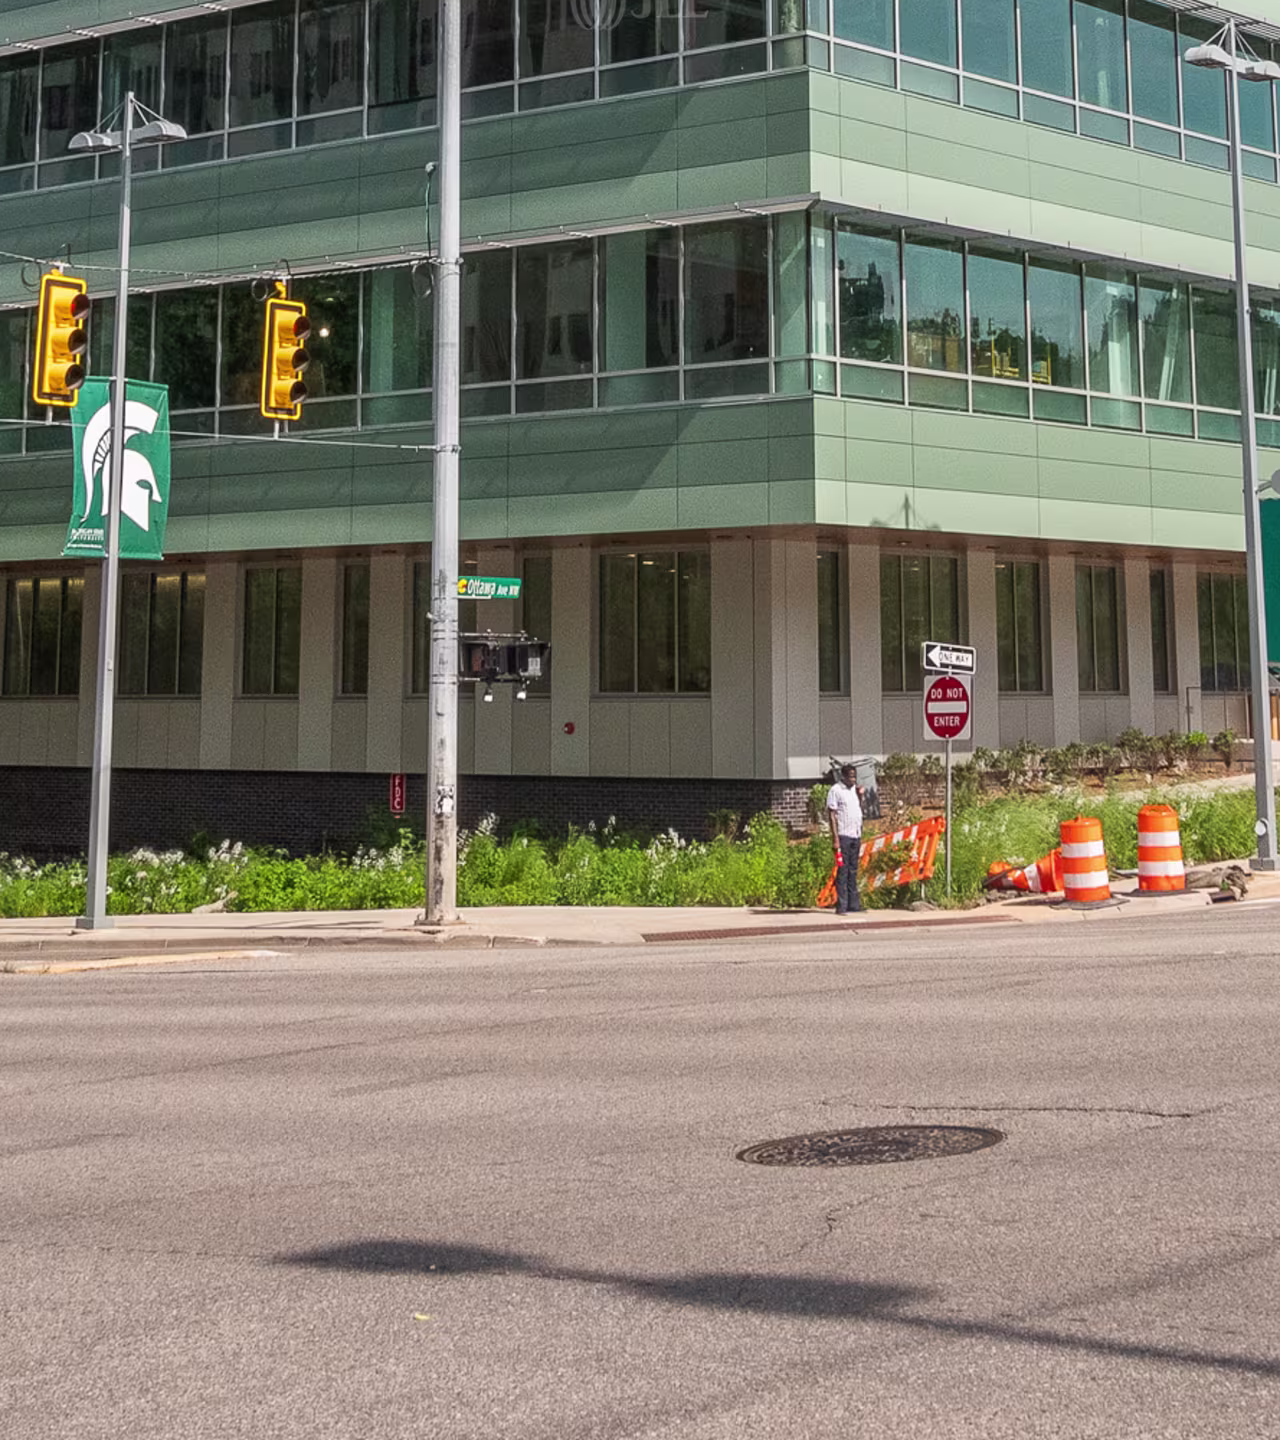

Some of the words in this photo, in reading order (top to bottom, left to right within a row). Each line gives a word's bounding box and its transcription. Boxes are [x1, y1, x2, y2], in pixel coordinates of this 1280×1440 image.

[468, 579, 496, 595] Ottawa
[938, 652, 953, 663] ONE
[955, 654, 969, 664] WAY
[931, 688, 942, 699] DO
[946, 687, 963, 699] NOT
[933, 715, 960, 727] ENTER
[393, 774, 401, 809] FDC
